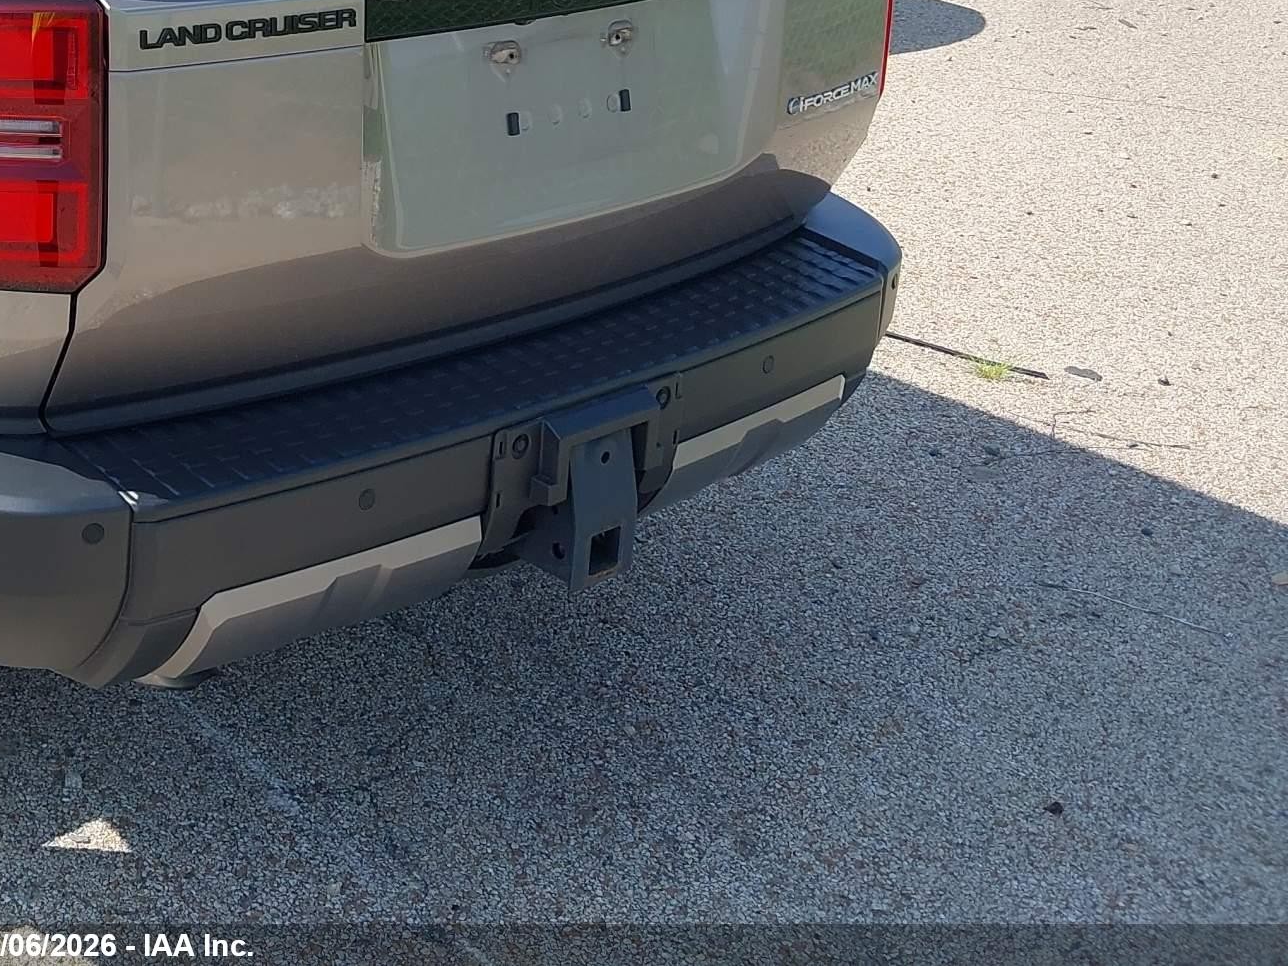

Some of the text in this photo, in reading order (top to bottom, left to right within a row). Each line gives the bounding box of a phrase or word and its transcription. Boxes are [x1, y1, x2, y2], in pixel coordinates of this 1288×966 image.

[139, 8, 357, 50] LAND CRUISER
[850, 71, 879, 94] MAX
